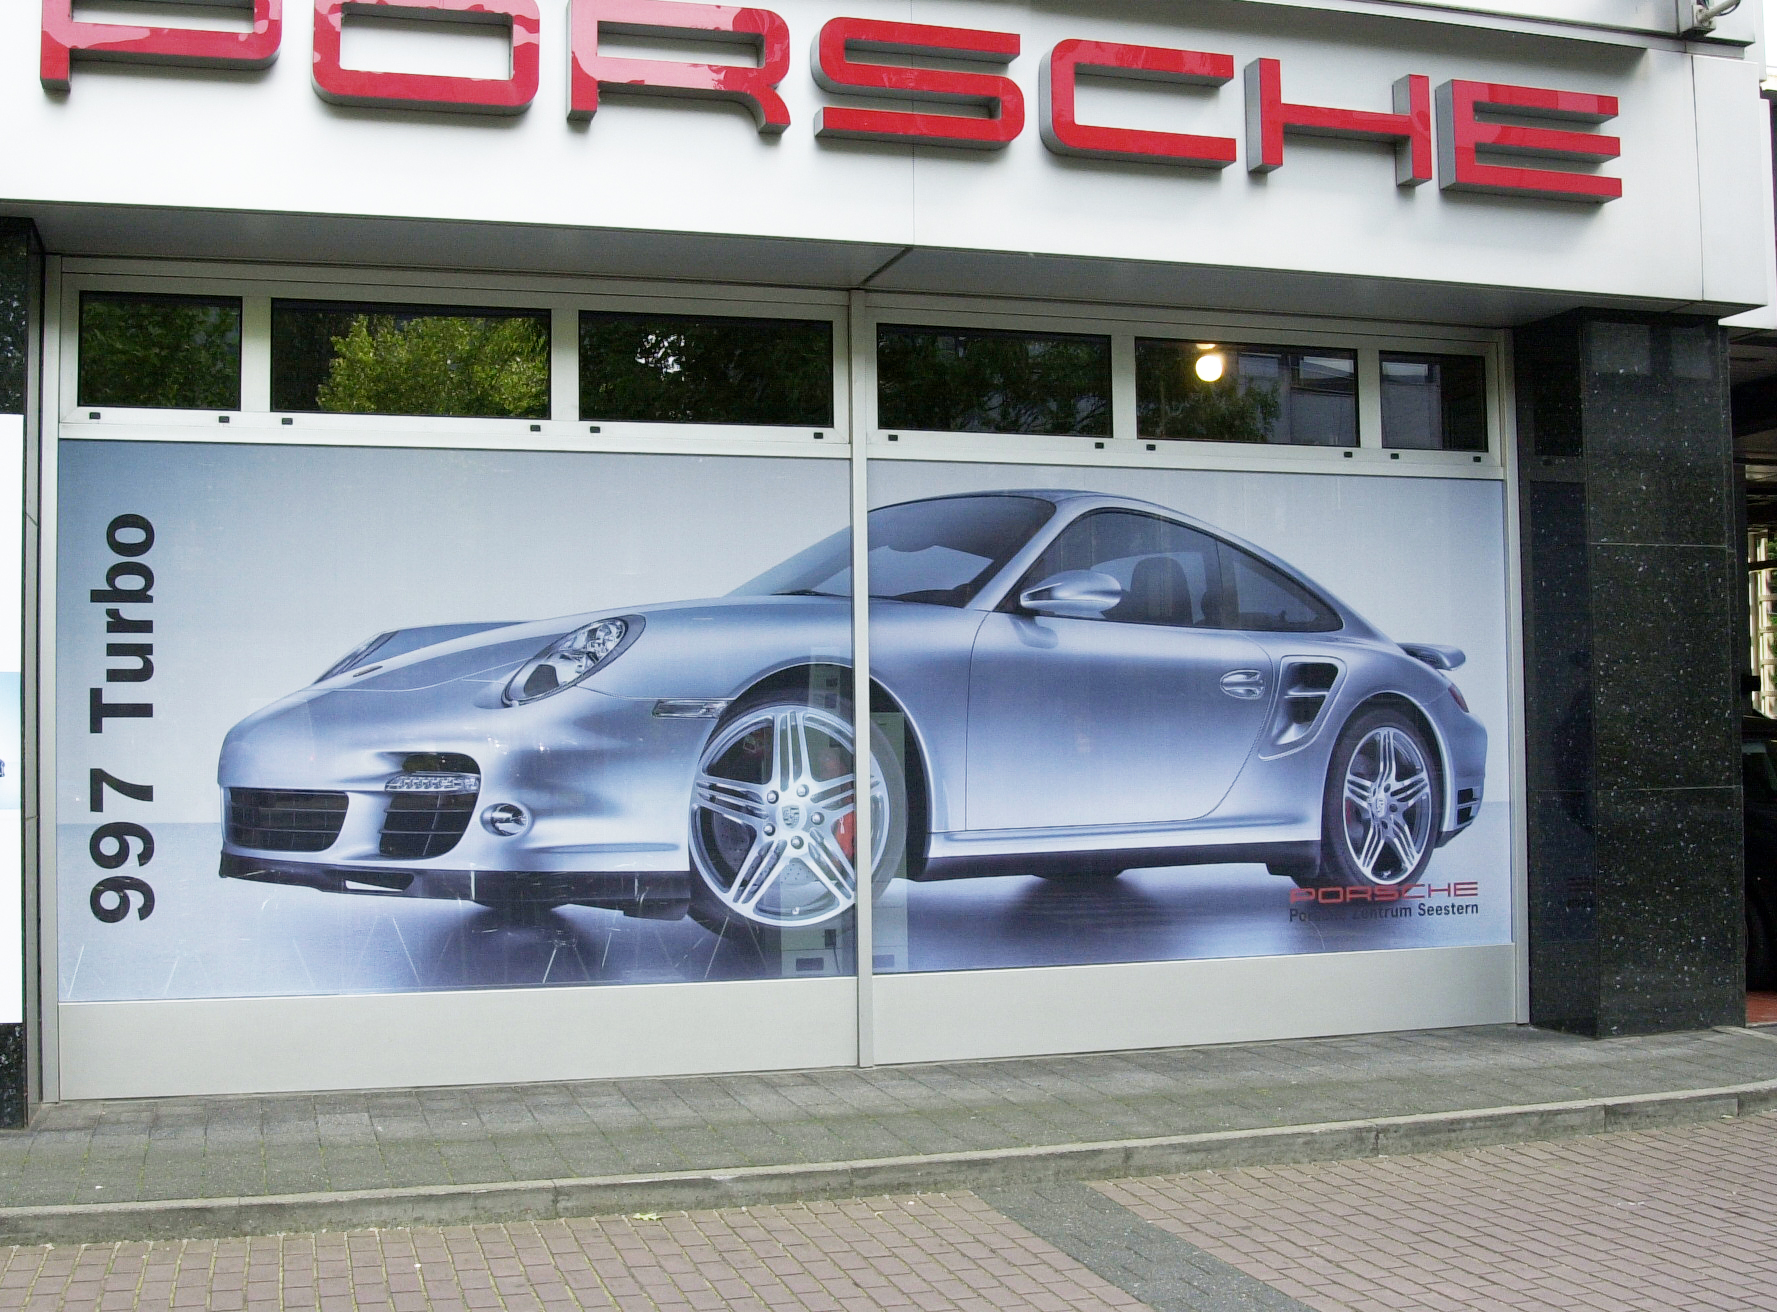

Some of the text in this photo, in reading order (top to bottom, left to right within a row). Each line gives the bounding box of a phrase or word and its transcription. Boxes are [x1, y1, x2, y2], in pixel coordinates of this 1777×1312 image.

[40, 0, 1623, 203] PORSCHE
[89, 513, 155, 924] 997 Turbo
[1289, 902, 1479, 922] Porh Zentrum Seestern
[1290, 881, 1479, 904] PORSCHE
